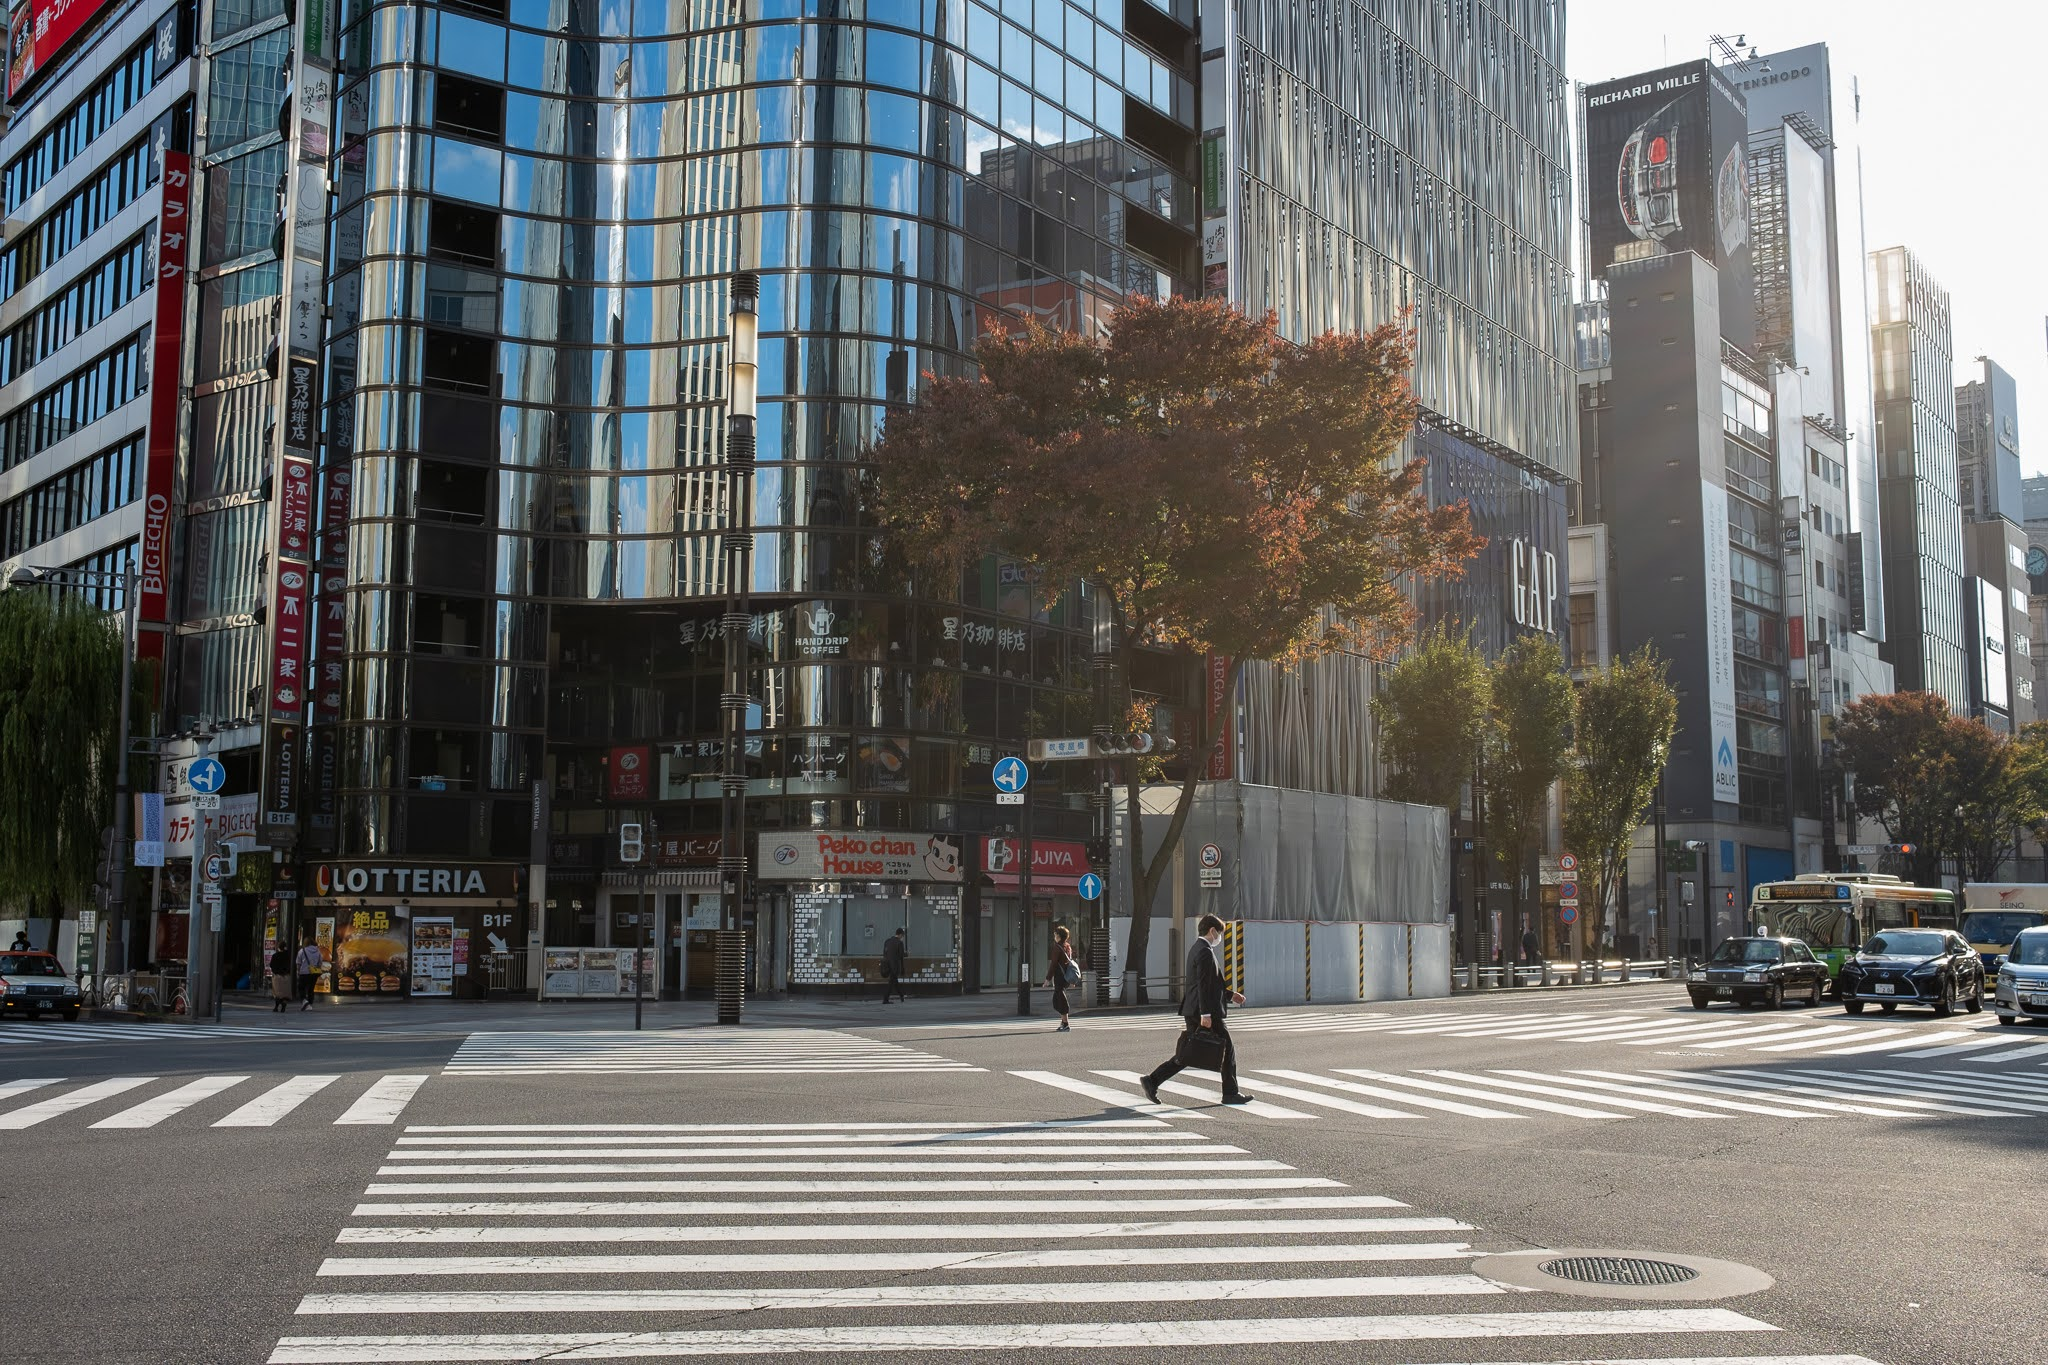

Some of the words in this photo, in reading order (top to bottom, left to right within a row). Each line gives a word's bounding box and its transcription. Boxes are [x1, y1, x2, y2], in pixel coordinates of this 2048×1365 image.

[1590, 84, 1651, 107] RICHARD
[1657, 72, 1701, 92] MILLE
[1736, 66, 1810, 91] TENSHODO
[1710, 73, 1732, 103] RICHARD
[1732, 95, 1747, 118] MILLE
[160, 169, 188, 279] カラオケ
[290, 366, 311, 441] 星乃珈琲店
[284, 479, 294, 529] レストラン
[294, 481, 308, 532] 不二家
[147, 493, 168, 551] ECHO
[143, 555, 163, 595] BIG
[1513, 538, 1557, 635] GAP
[279, 595, 300, 678] 不二家
[795, 637, 821, 646] HAND
[825, 636, 849, 646] DRIP
[942, 616, 1027, 654] 星乃珈琲店
[802, 646, 840, 655] COFFEE
[807, 736, 831, 748] 銀座
[1049, 741, 1085, 751] 数寄屋橋
[968, 745, 992, 765] 銀座
[279, 742, 292, 810] LOTTERIA
[800, 770, 837, 782] 不二家
[1716, 772, 1736, 787] ABLIC
[614, 785, 644, 795] レストラン
[219, 814, 238, 837] BIG
[271, 814, 291, 823] B1F
[817, 834, 867, 855] Peko
[869, 836, 917, 856] chan
[823, 855, 884, 875] House
[332, 868, 486, 893] LOTTERIA
[353, 911, 390, 930] 絶品
[482, 914, 513, 927] B1F
